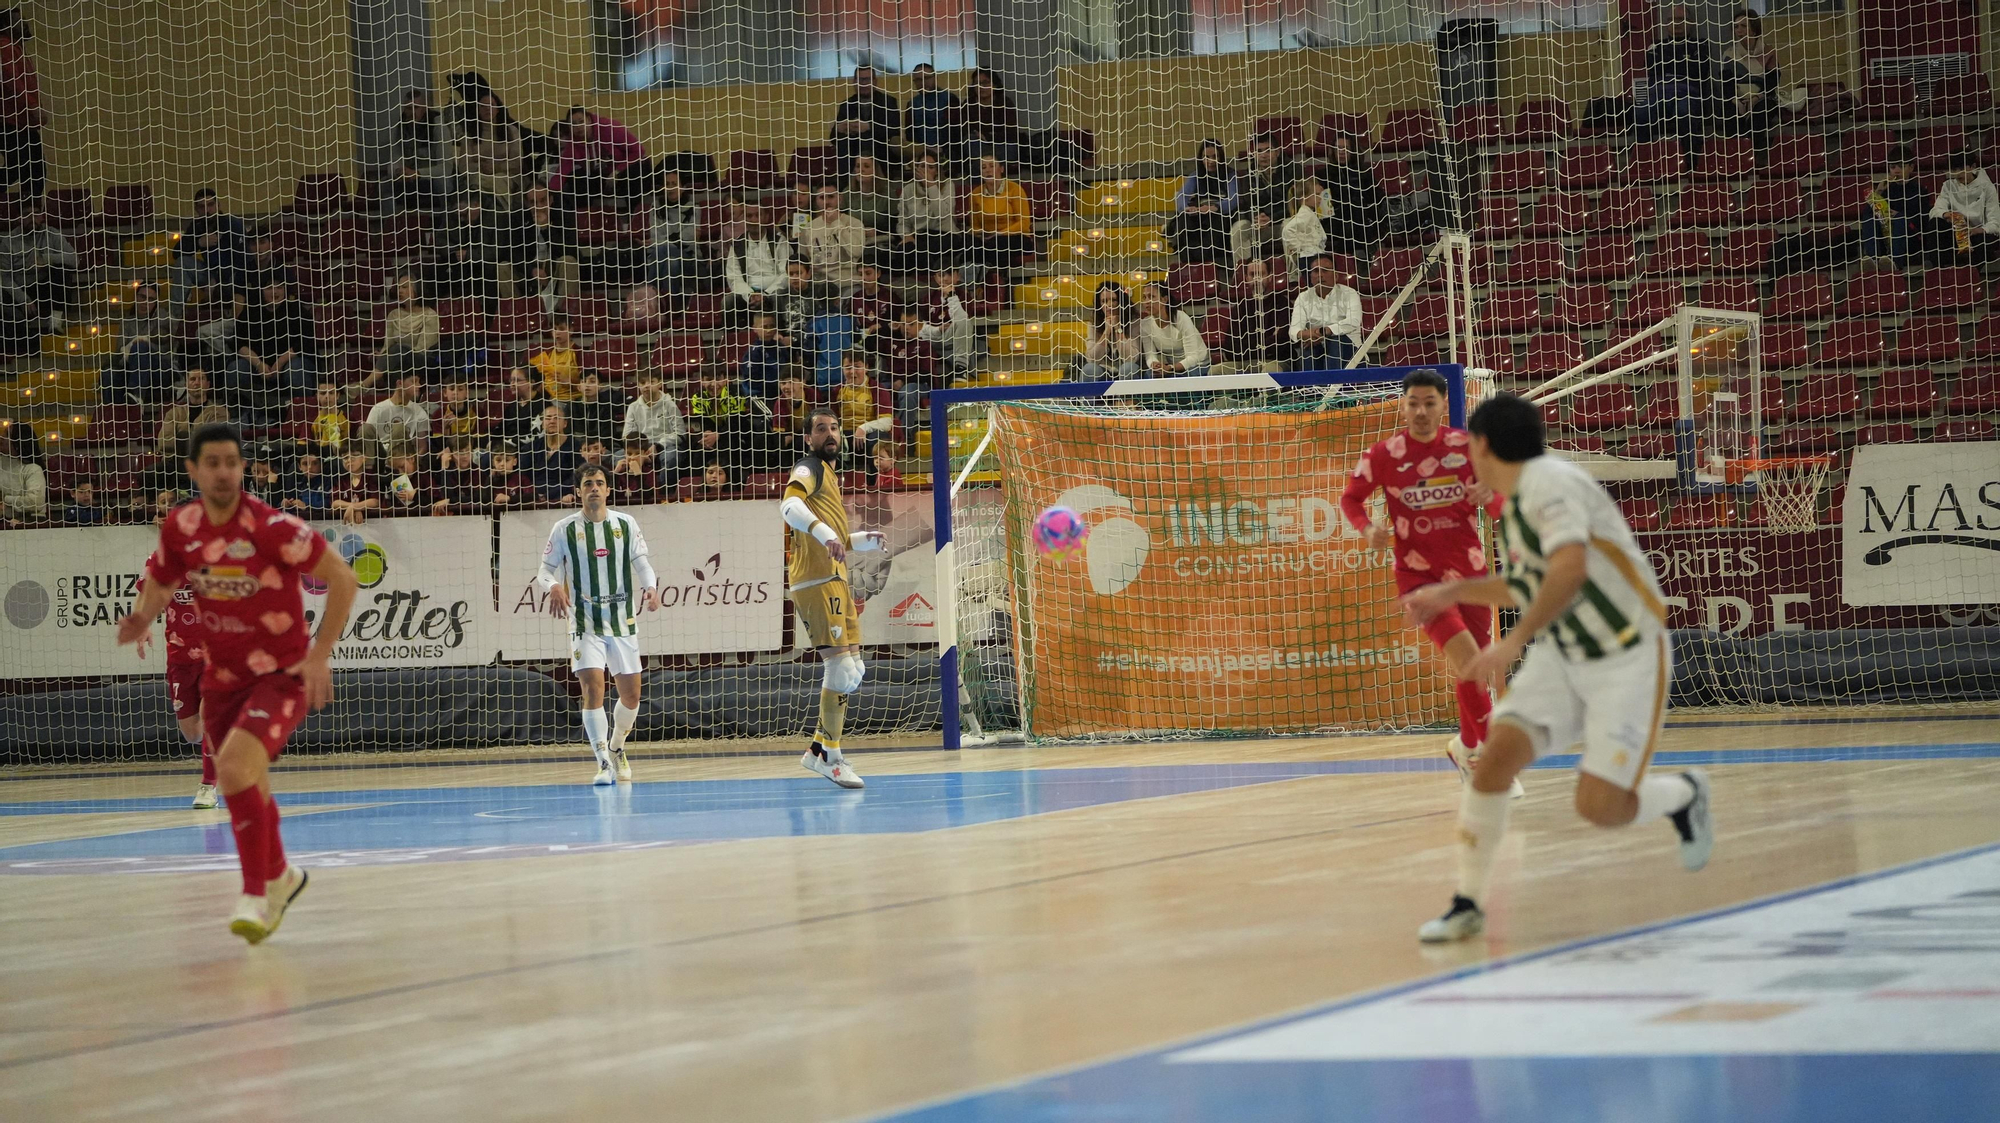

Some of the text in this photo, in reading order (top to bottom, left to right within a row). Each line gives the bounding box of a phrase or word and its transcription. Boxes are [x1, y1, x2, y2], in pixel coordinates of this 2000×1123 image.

[1169, 496, 1397, 547] INGED
[1174, 547, 1397, 577] CONSTRUCTORA
[73, 573, 140, 599] RUIZ
[57, 577, 68, 628] GRUPO
[828, 596, 843, 615] 12
[329, 644, 443, 660] ANIMACIONES
[1098, 639, 1419, 677] #elnaranjaestendencia
